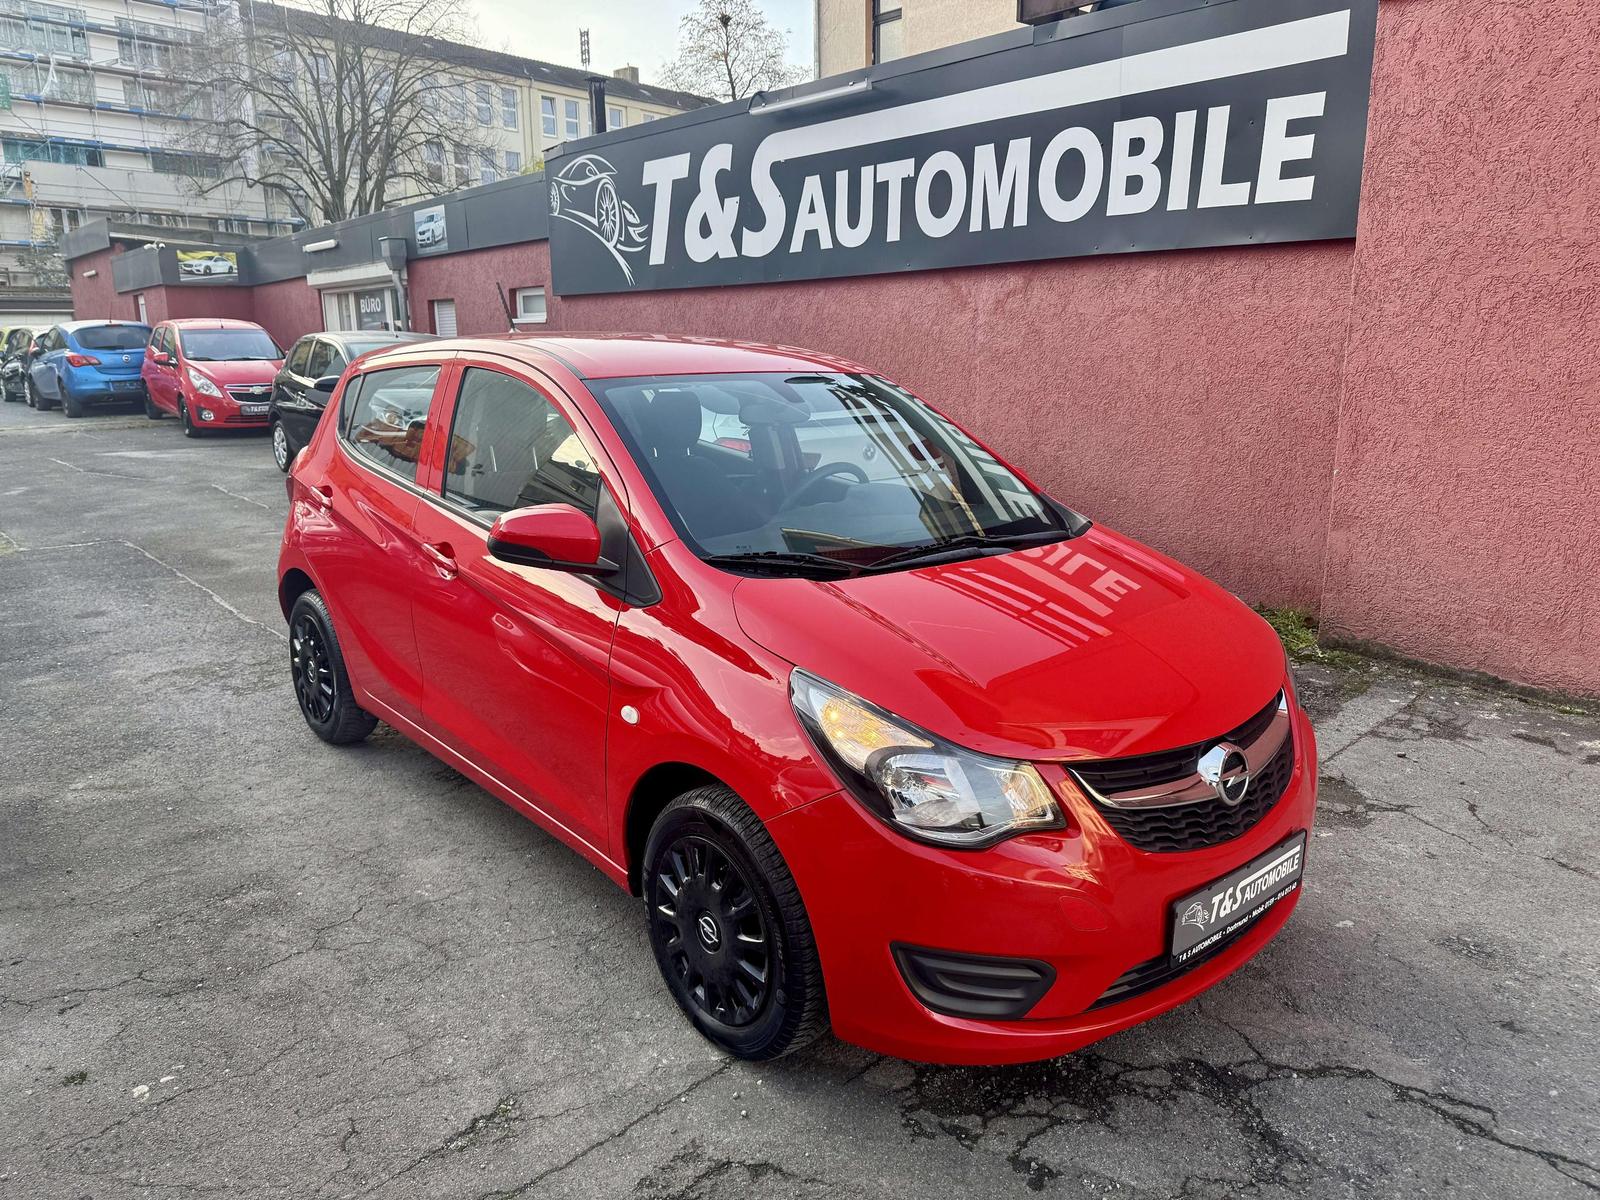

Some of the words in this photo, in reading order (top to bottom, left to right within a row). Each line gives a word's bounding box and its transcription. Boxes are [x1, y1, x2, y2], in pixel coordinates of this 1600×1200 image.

[642, 132, 787, 266] T&S
[788, 91, 1327, 254] AUTOMOBILE
[360, 296, 381, 313] BÜRO
[1210, 881, 1242, 924] T&S
[1242, 853, 1300, 905] AUTOMOBILE
[1191, 930, 1223, 955] AUTOMOBILE
[1226, 914, 1249, 934] Dortmund
